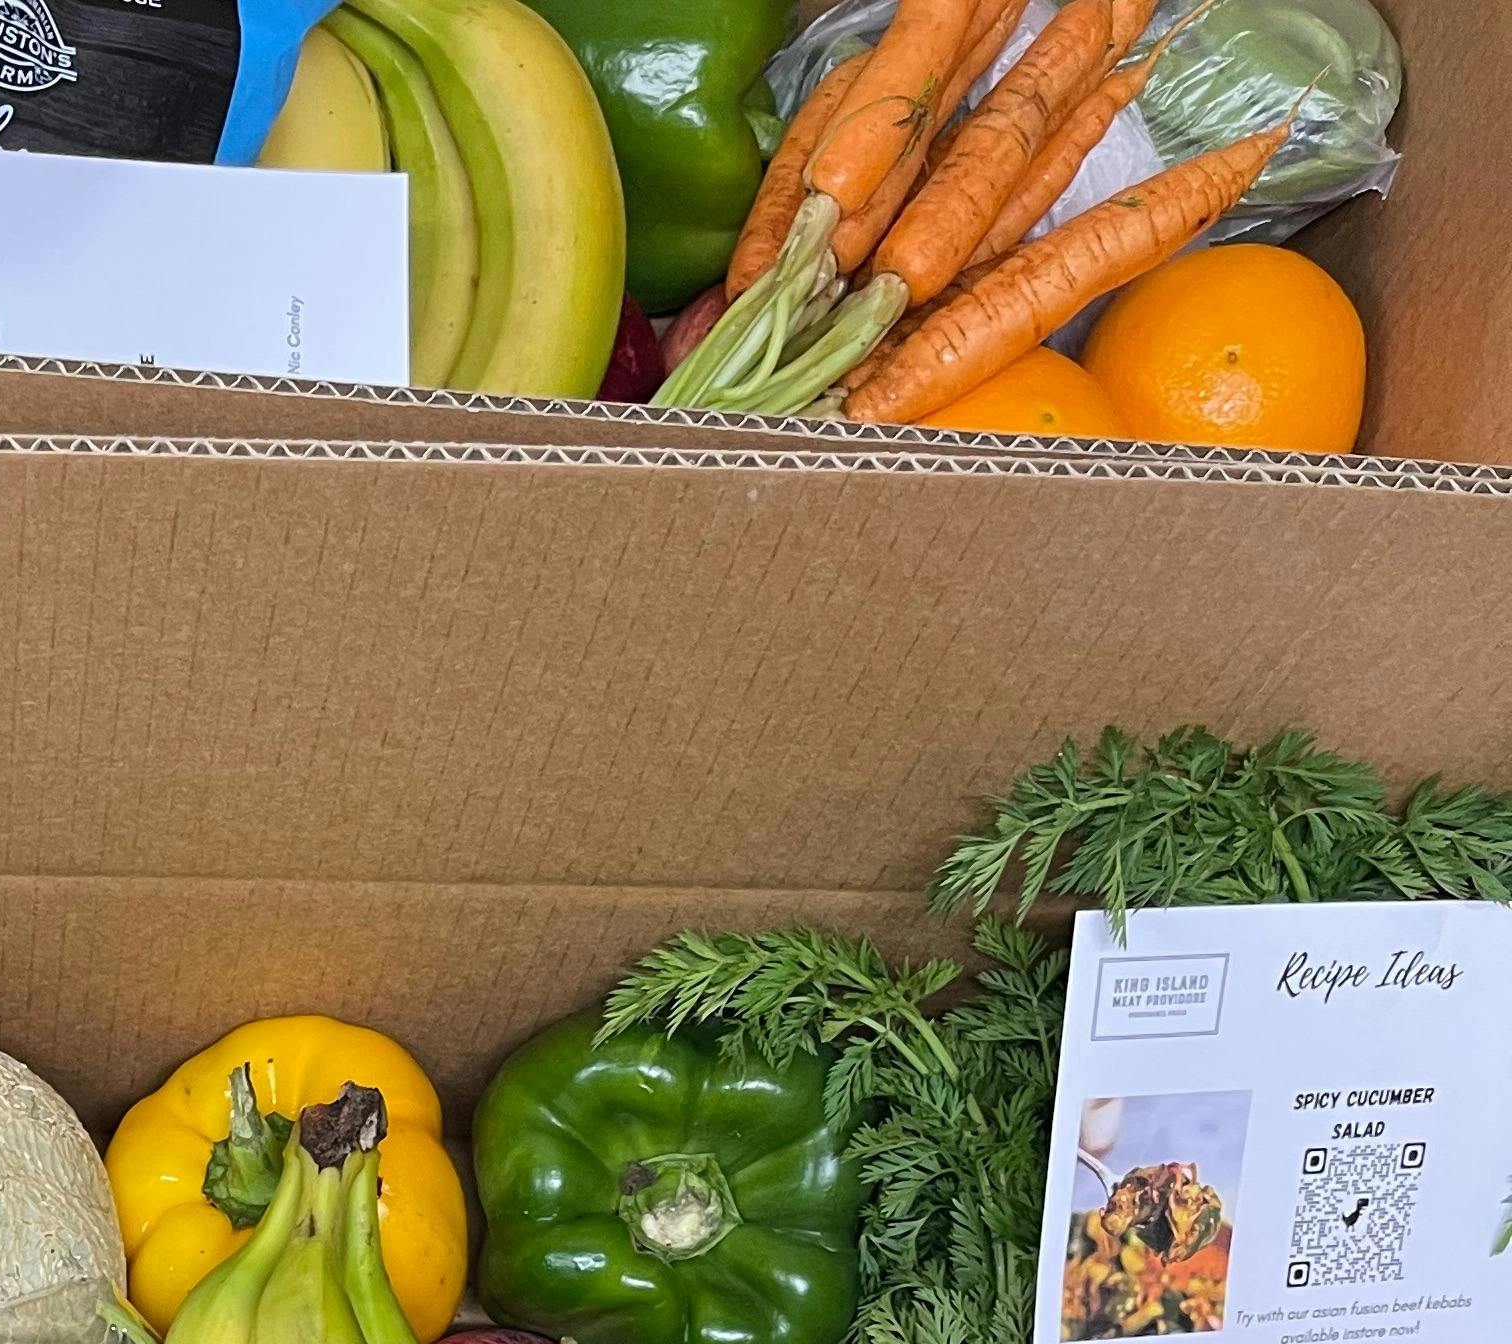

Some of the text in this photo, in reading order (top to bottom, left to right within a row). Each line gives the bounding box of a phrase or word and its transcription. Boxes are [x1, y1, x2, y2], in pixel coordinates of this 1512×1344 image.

[286, 296, 304, 374] Nic Conley
[1114, 974, 1209, 993] KING ISLAND
[1276, 950, 1464, 1005] Recipe Ideas
[1112, 995, 1141, 1007] MEAT
[1293, 1087, 1435, 1110] SPICY CUCUMBER
[1331, 1121, 1385, 1139] SALAD
[1236, 1294, 1472, 1328] Try with our asian fusion beef kebabs
[1280, 1320, 1421, 1344] available instore now!
